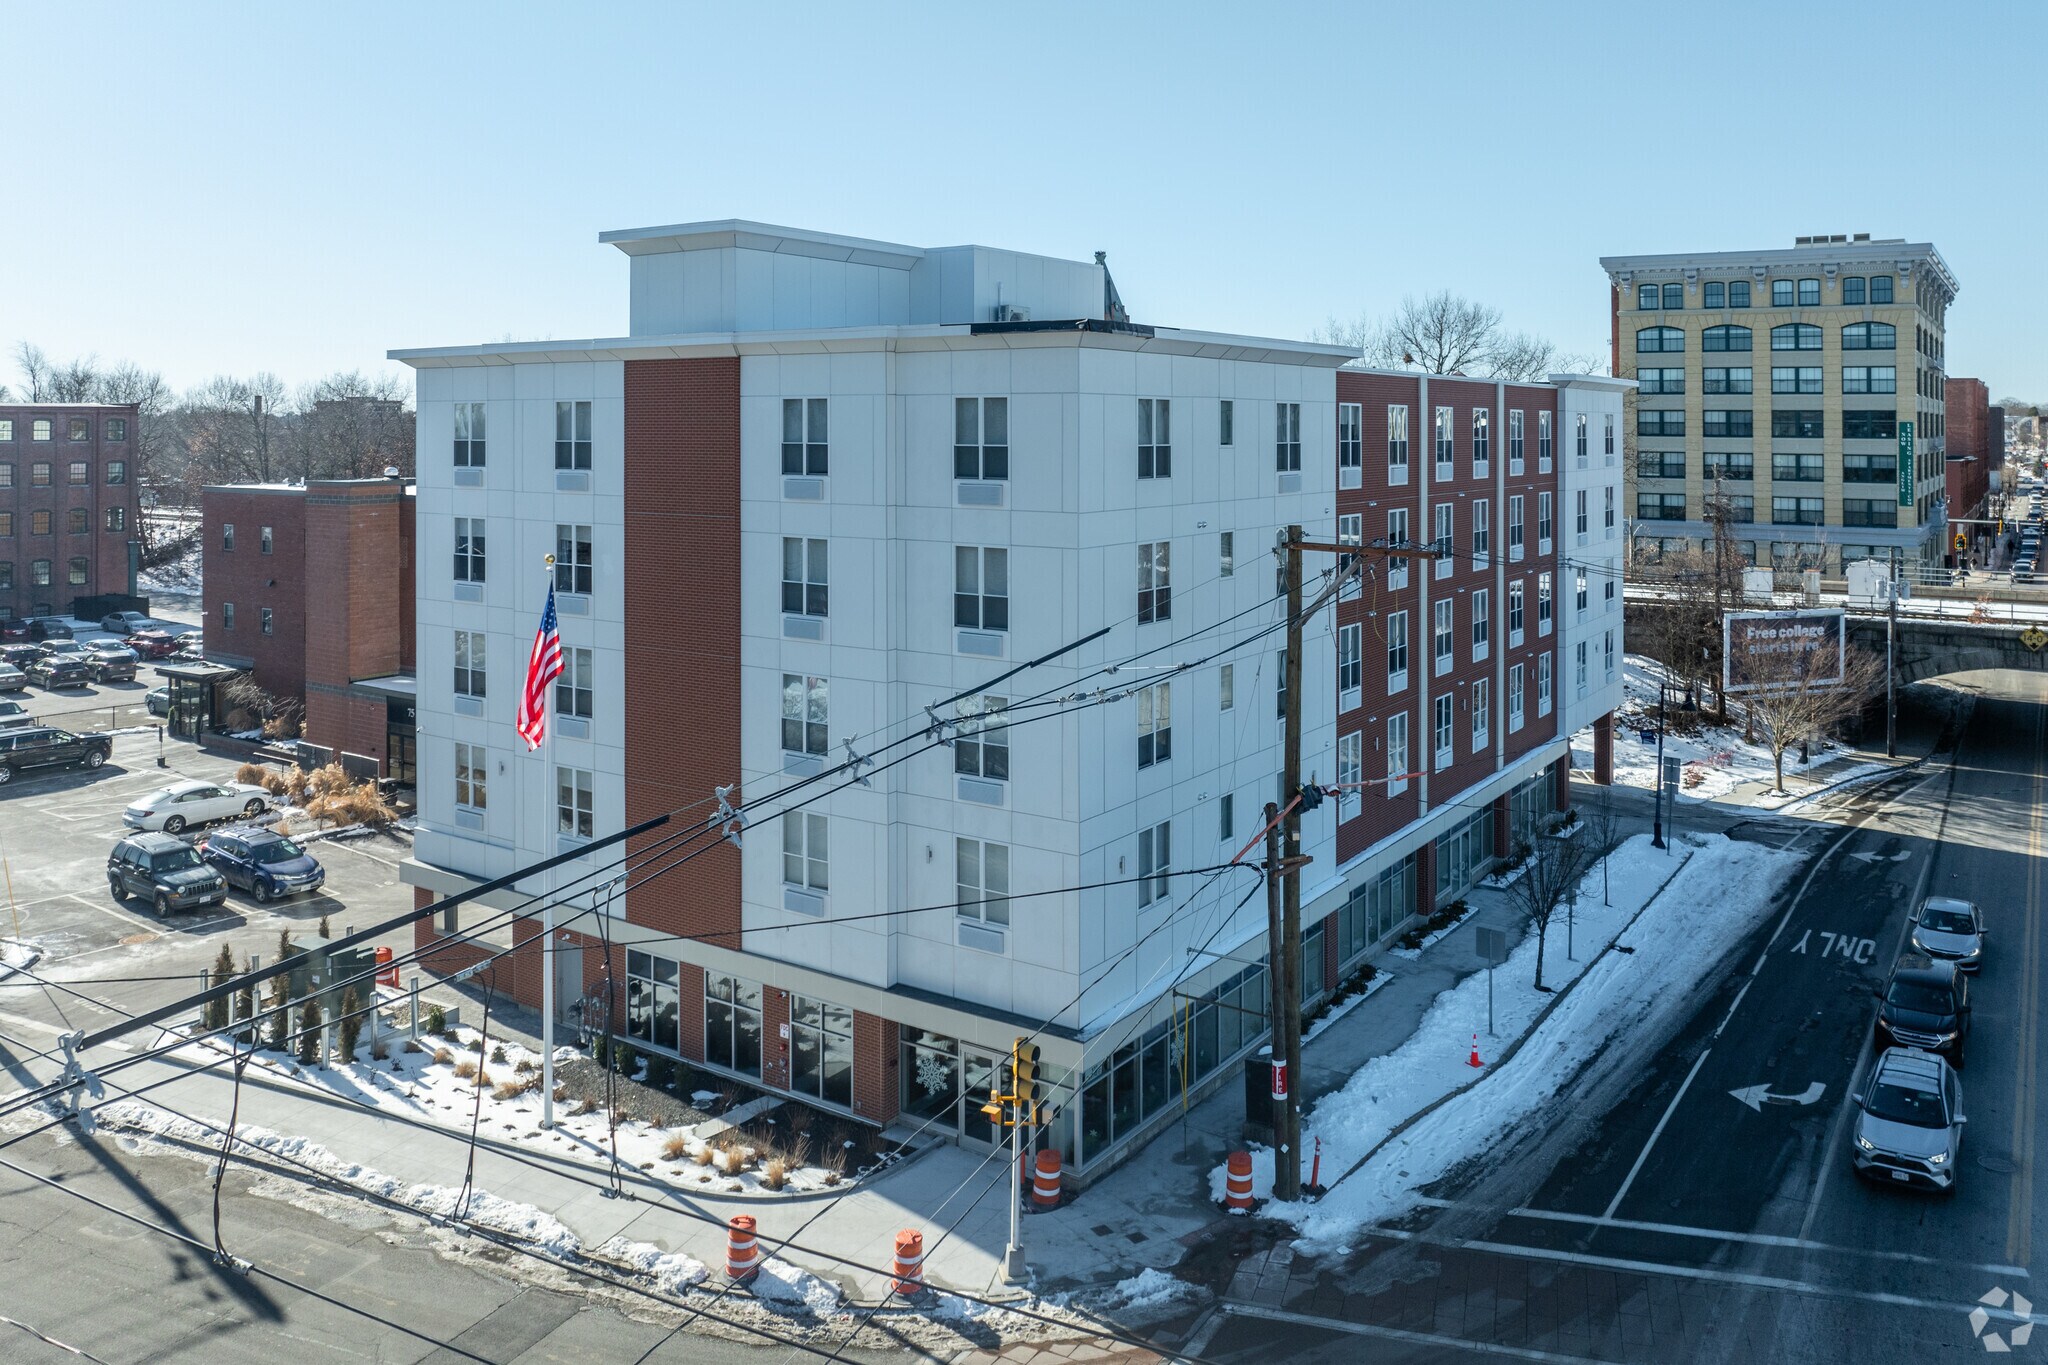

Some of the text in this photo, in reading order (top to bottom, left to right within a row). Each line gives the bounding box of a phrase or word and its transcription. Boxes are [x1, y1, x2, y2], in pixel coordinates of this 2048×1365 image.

[1747, 625, 1825, 639] Free college
[1790, 929, 1876, 965] ONLY
